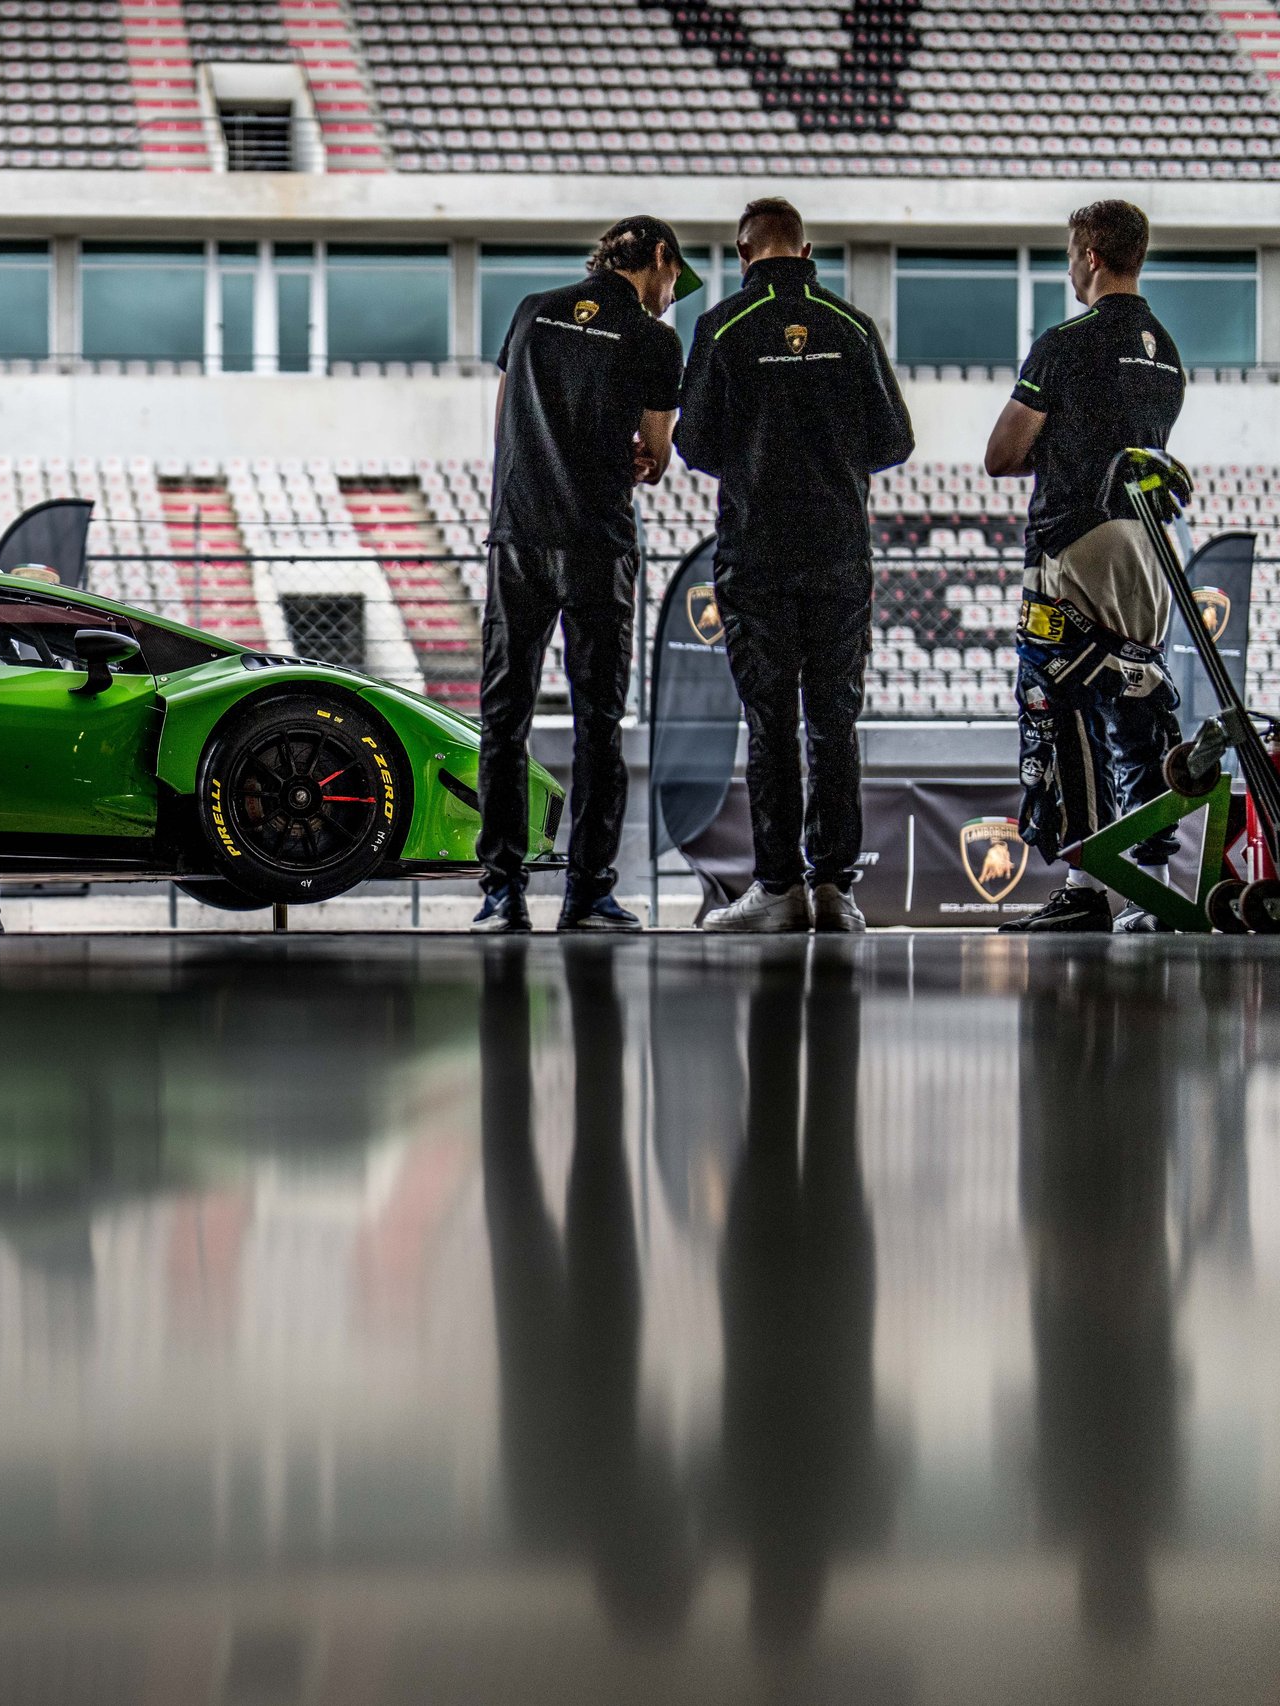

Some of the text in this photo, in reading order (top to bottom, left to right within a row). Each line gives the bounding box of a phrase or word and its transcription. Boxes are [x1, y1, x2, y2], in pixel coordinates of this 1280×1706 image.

[535, 316, 622, 340] SQUADRA CORSE
[757, 352, 842, 364] SQUADRA CORSE
[1118, 357, 1155, 366] SQUADRA
[1124, 670, 1144, 684] MP
[211, 778, 242, 857] PIRELLI
